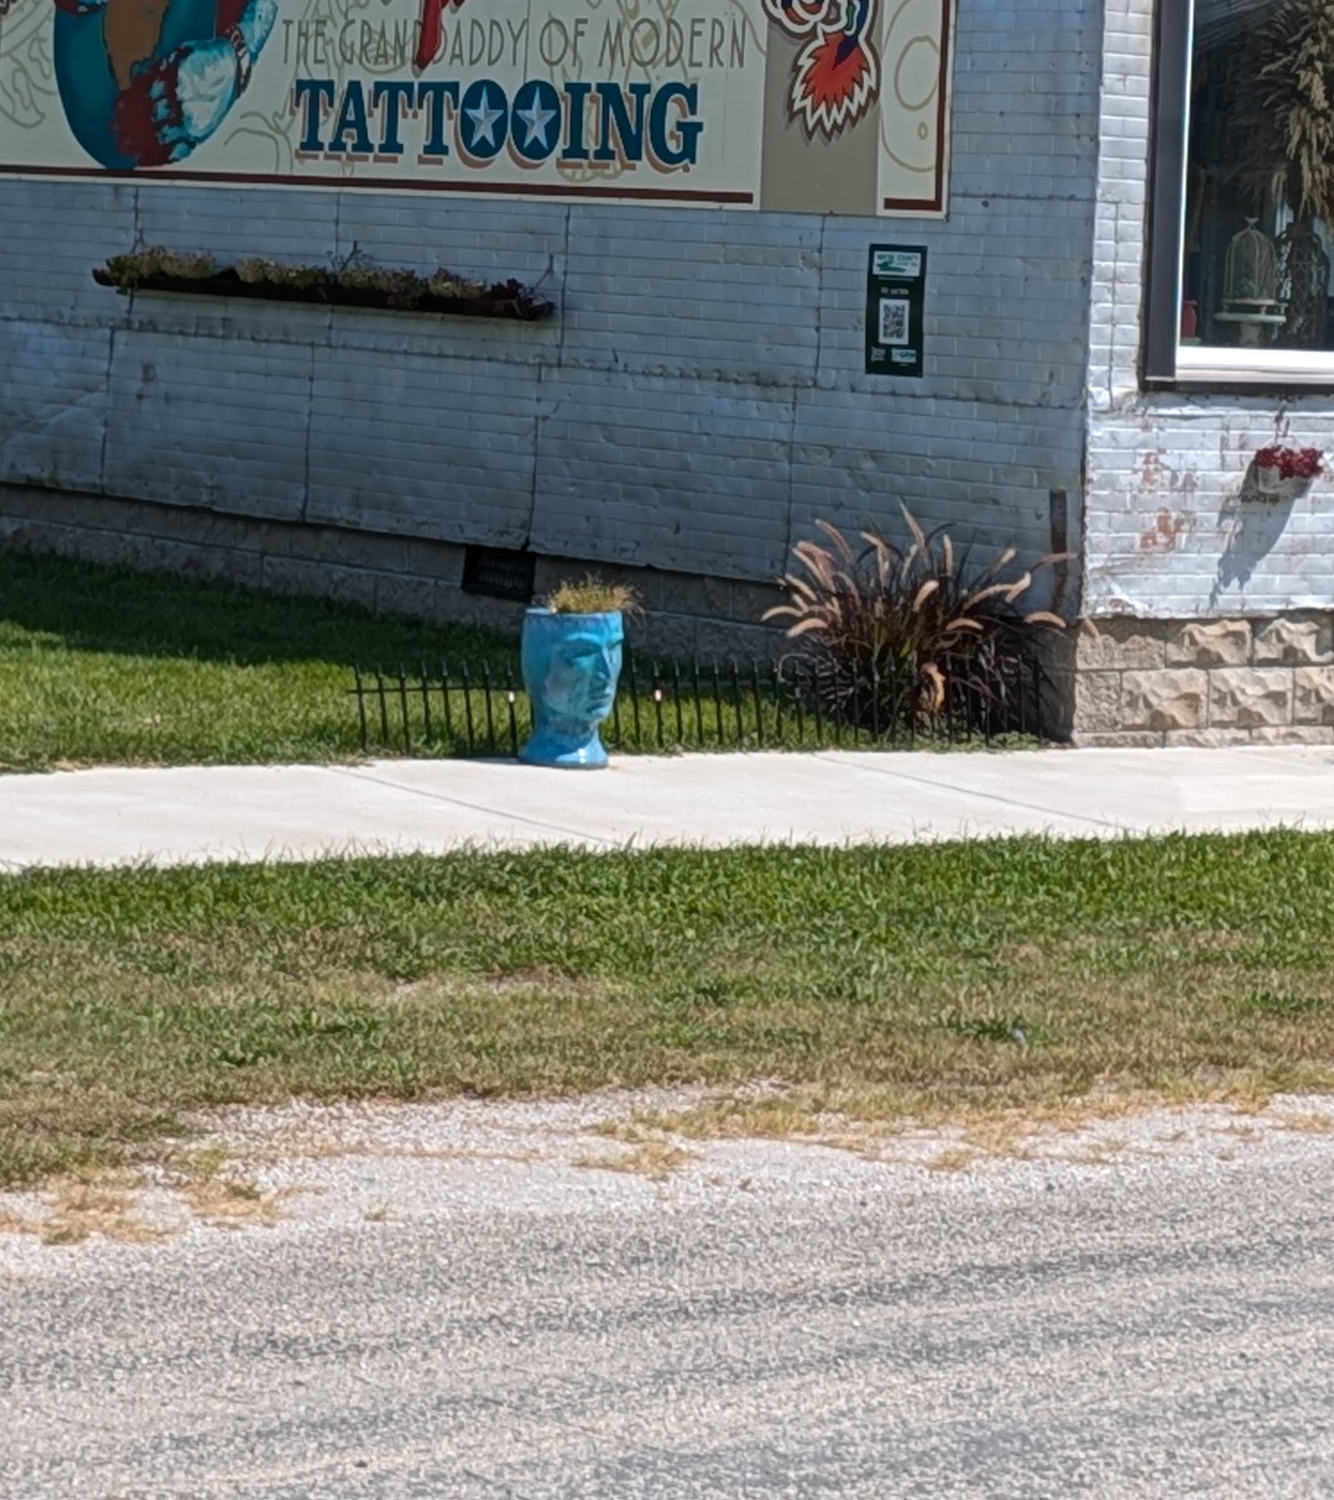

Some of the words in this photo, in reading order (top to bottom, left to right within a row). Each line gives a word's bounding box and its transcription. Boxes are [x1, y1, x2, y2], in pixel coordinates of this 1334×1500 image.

[282, 18, 328, 66] THE
[539, 17, 589, 67] OF
[598, 16, 747, 69] MODERN
[294, 78, 704, 167] TATTOOING
